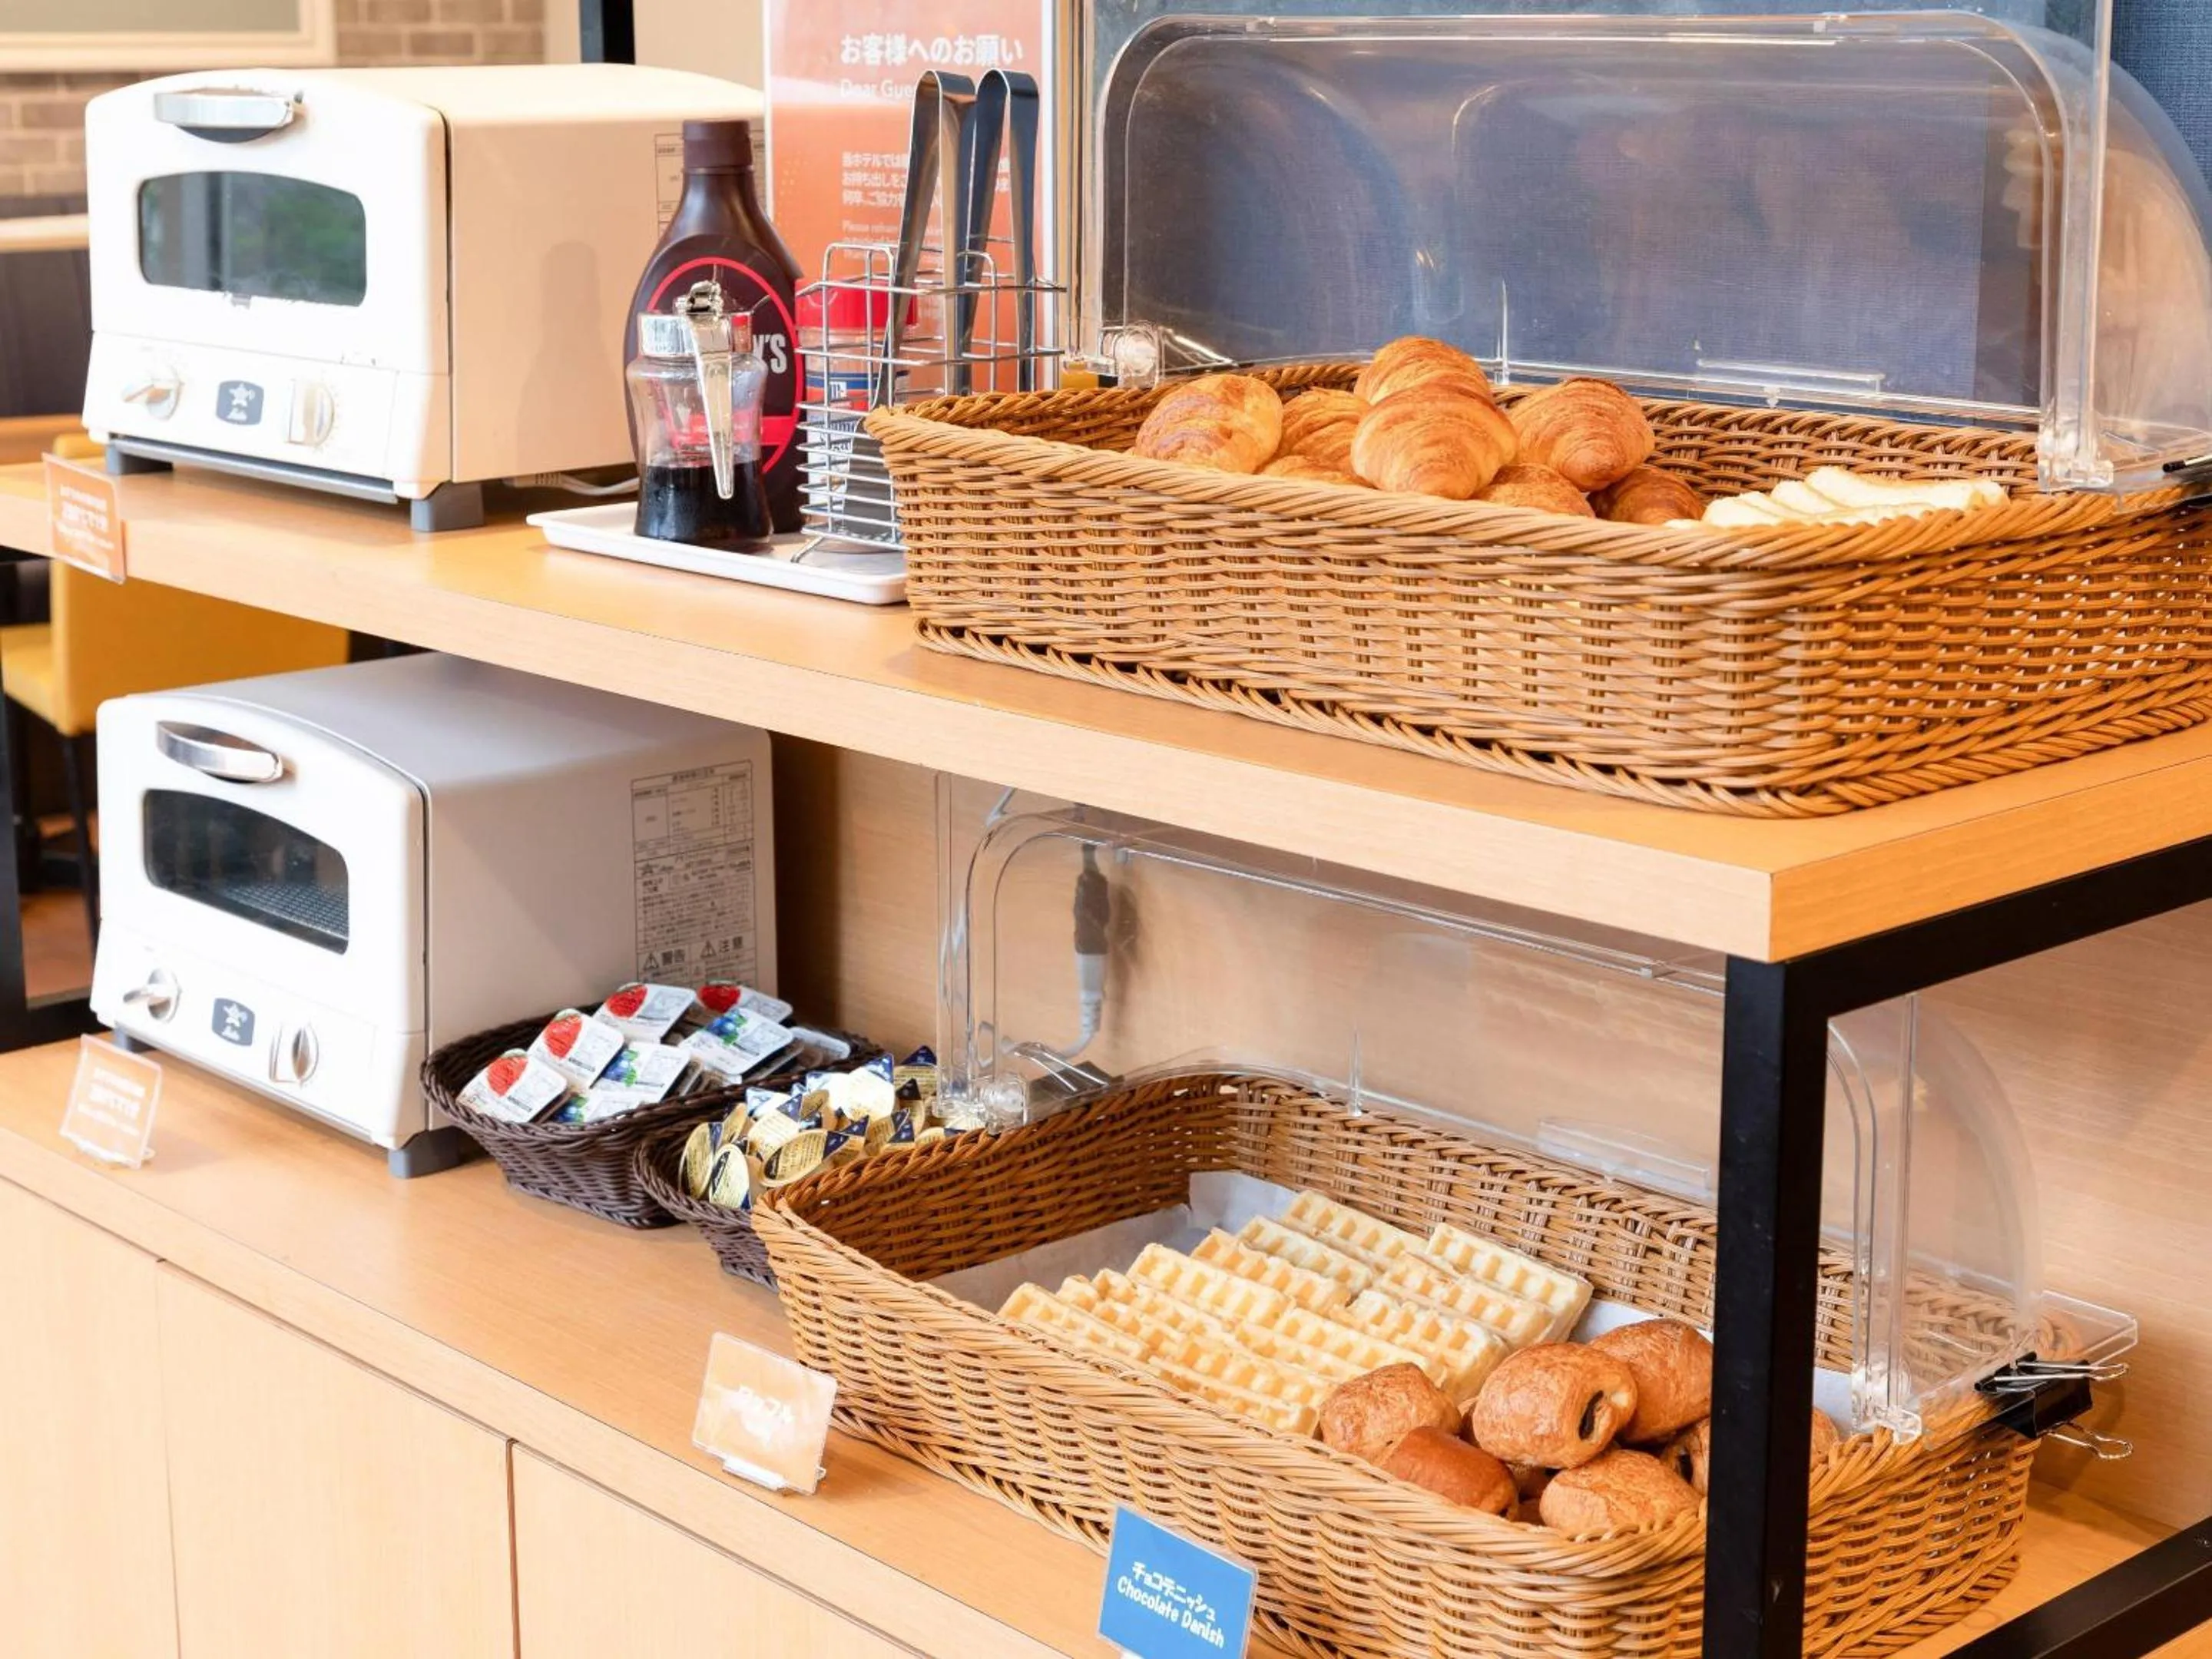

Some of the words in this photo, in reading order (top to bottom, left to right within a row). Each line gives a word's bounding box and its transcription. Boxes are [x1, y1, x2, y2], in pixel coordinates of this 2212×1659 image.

[841, 34, 1023, 66] お客様へのお願い
[880, 79, 916, 98] Gue
[1117, 1575, 1179, 1622] Chocolate
[1181, 1611, 1224, 1649] Danish
[1132, 1561, 1216, 1622] チョコデニッシュ
